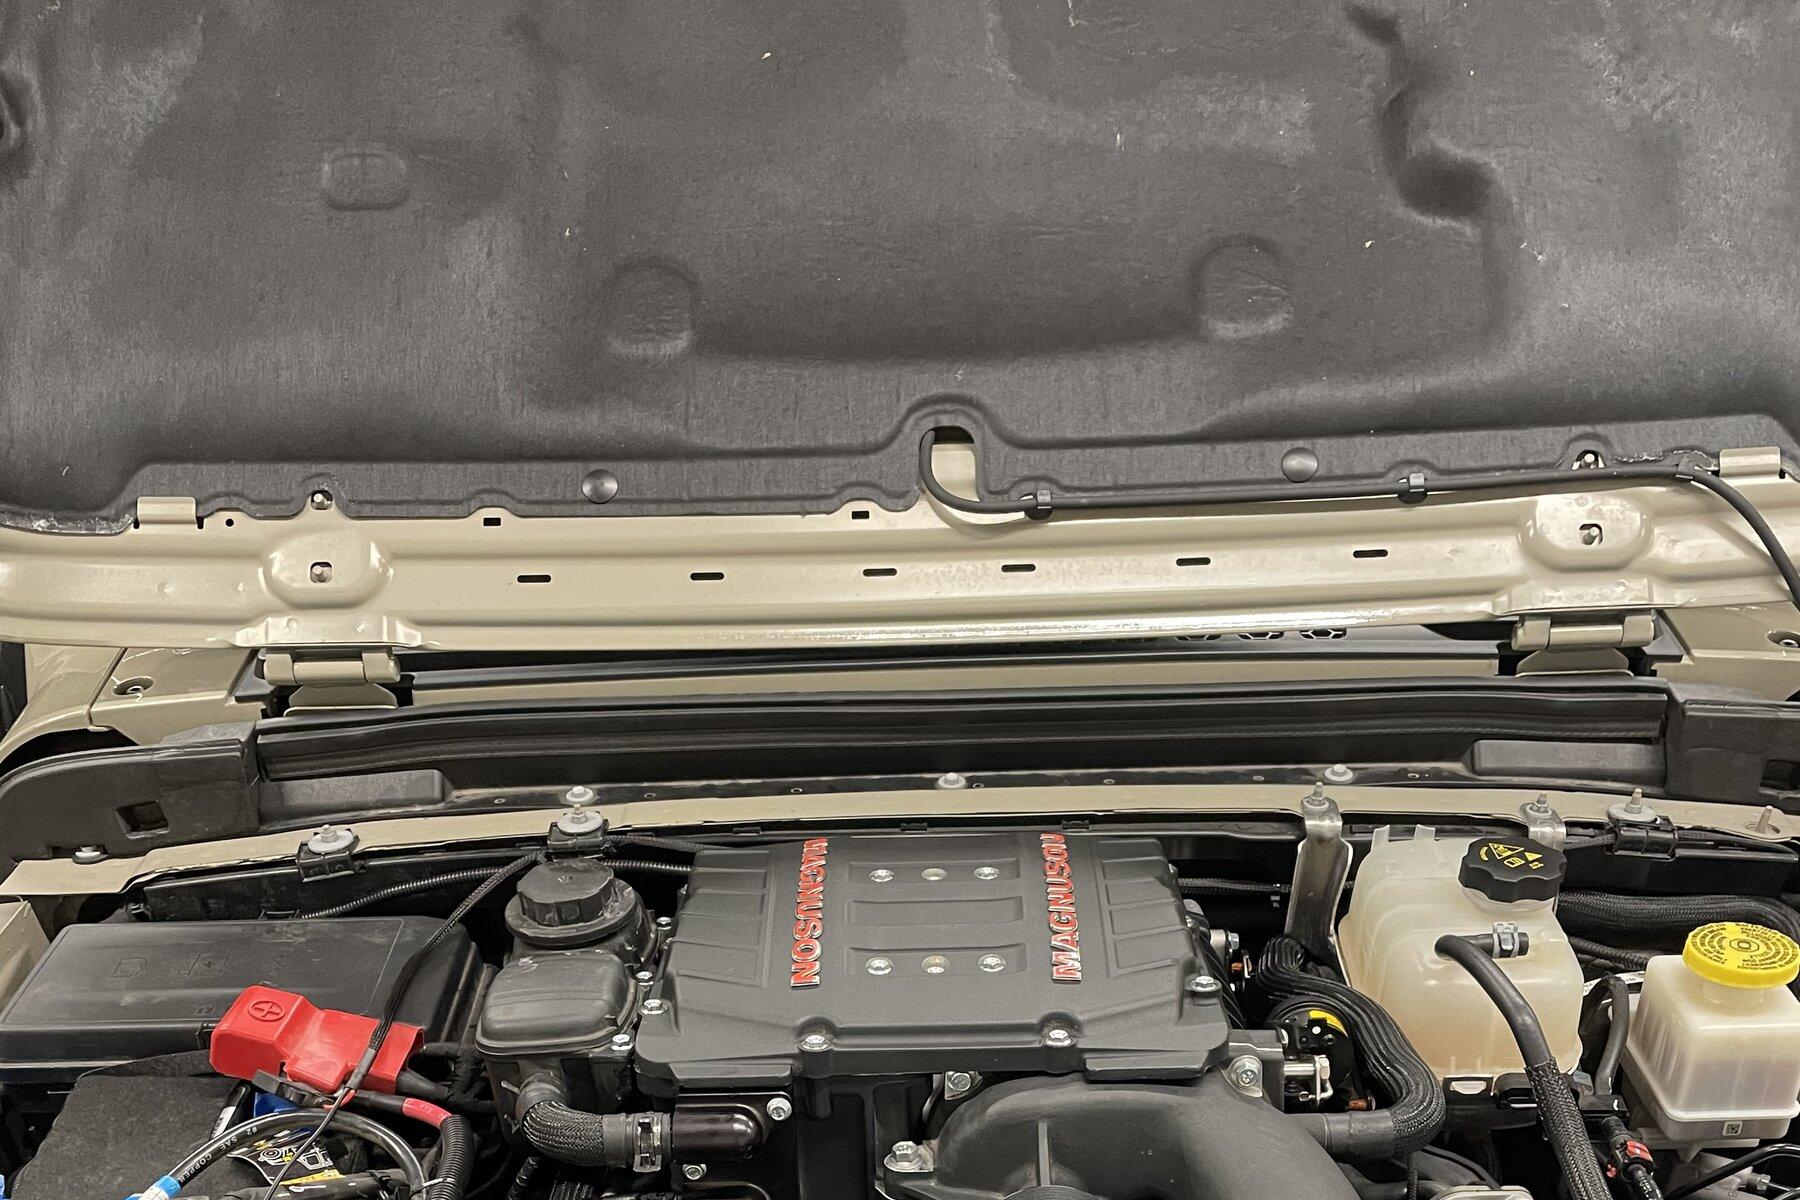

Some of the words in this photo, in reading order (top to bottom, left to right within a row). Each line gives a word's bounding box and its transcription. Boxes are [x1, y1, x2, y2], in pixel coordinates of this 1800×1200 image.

[791, 836, 829, 987] MAGNUSON
[1040, 832, 1081, 980] MAGNUSON
[178, 1153, 212, 1183] COPPER
[219, 1136, 238, 1151] SAE
